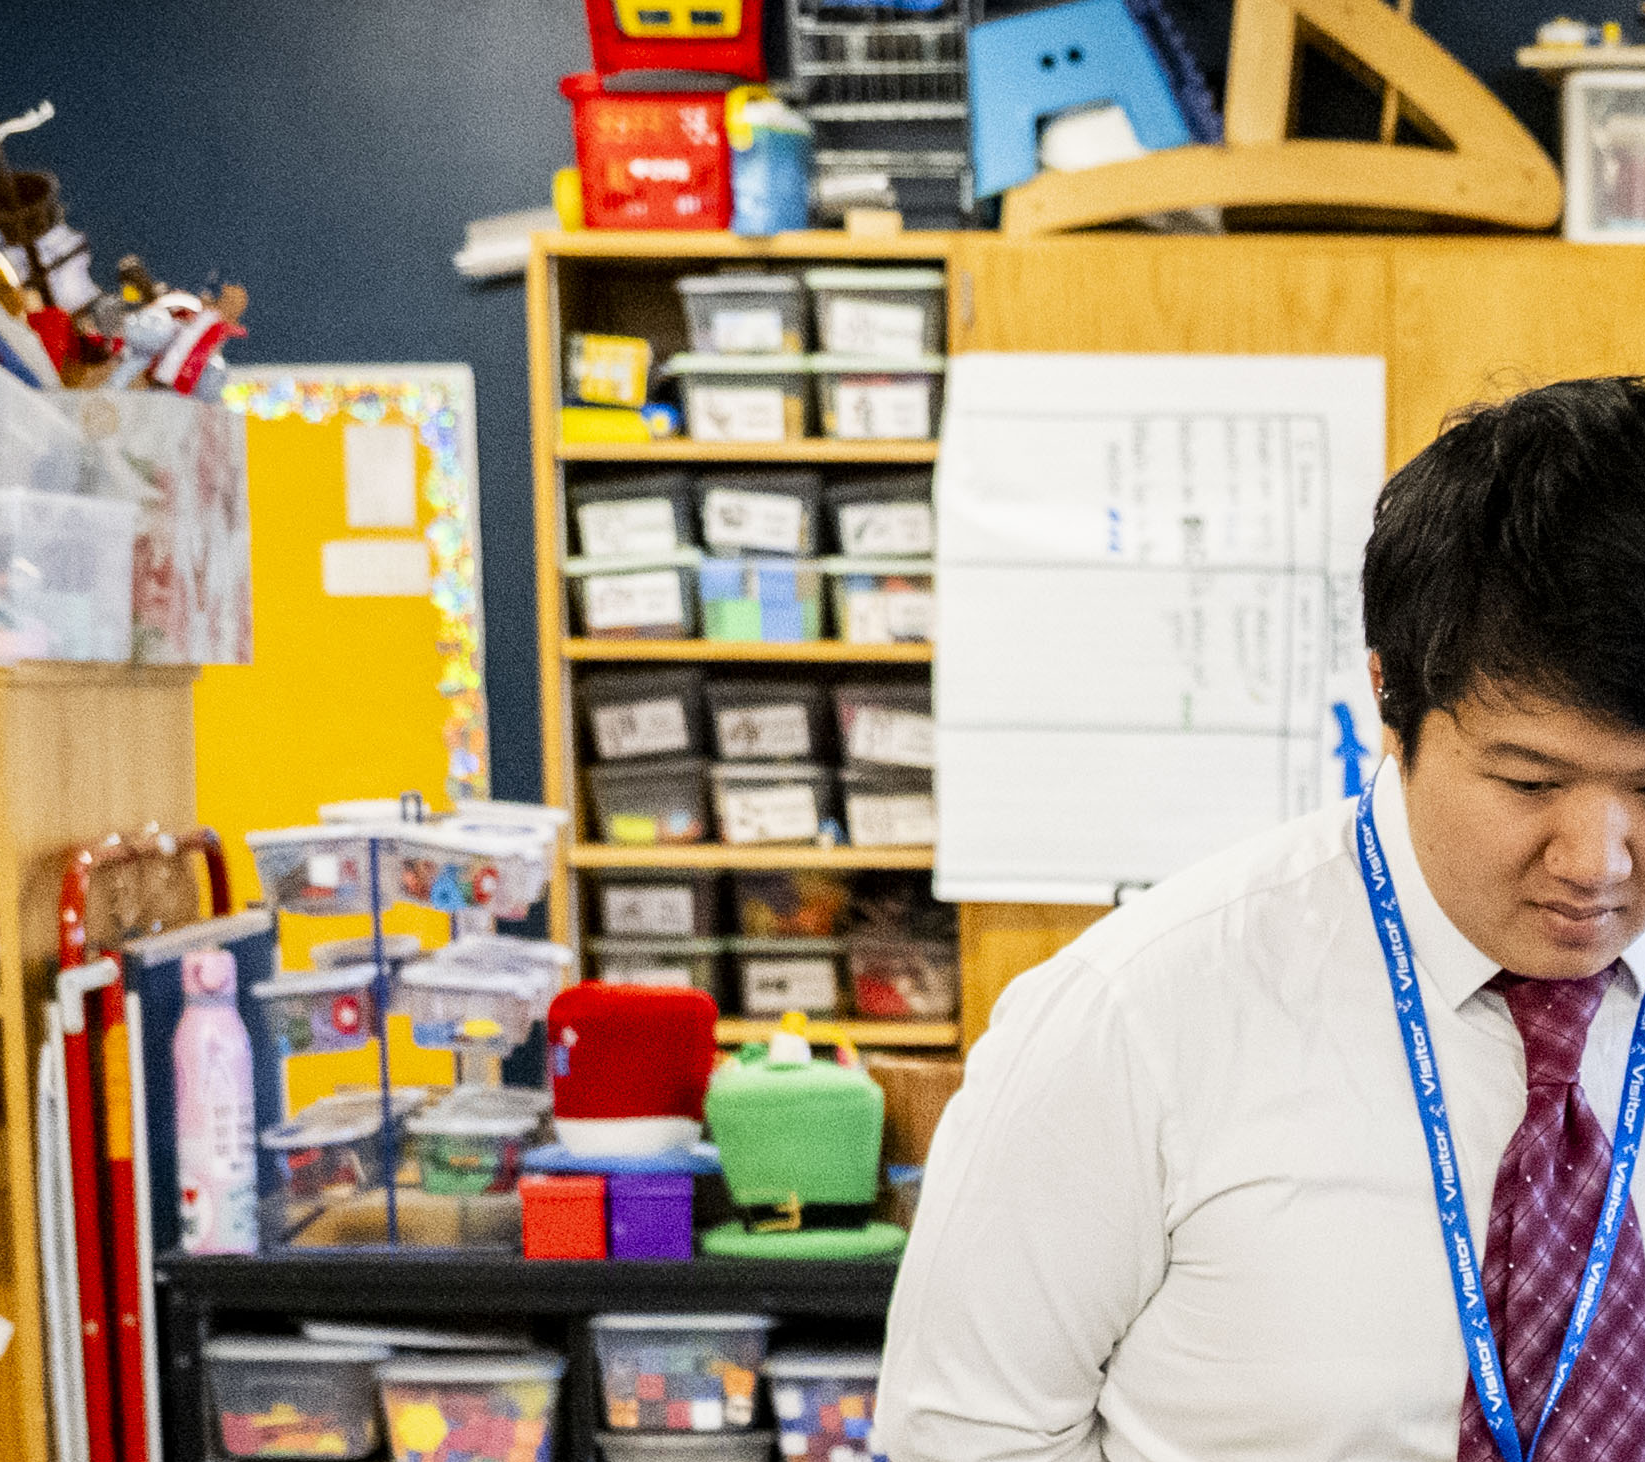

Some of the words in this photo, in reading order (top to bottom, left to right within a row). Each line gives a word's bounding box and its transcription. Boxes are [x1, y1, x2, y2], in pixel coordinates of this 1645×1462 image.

[1361, 823, 1387, 891] Visitor
[1384, 918, 1413, 991] Visitor
[1410, 1021, 1436, 1096] Visitor
[1433, 1126, 1457, 1202] Visitor
[1603, 1162, 1629, 1233] Visitor
[1454, 1231, 1479, 1309] Visitor
[1575, 1262, 1603, 1335] Visitor
[1476, 1336, 1503, 1413] Visitor
